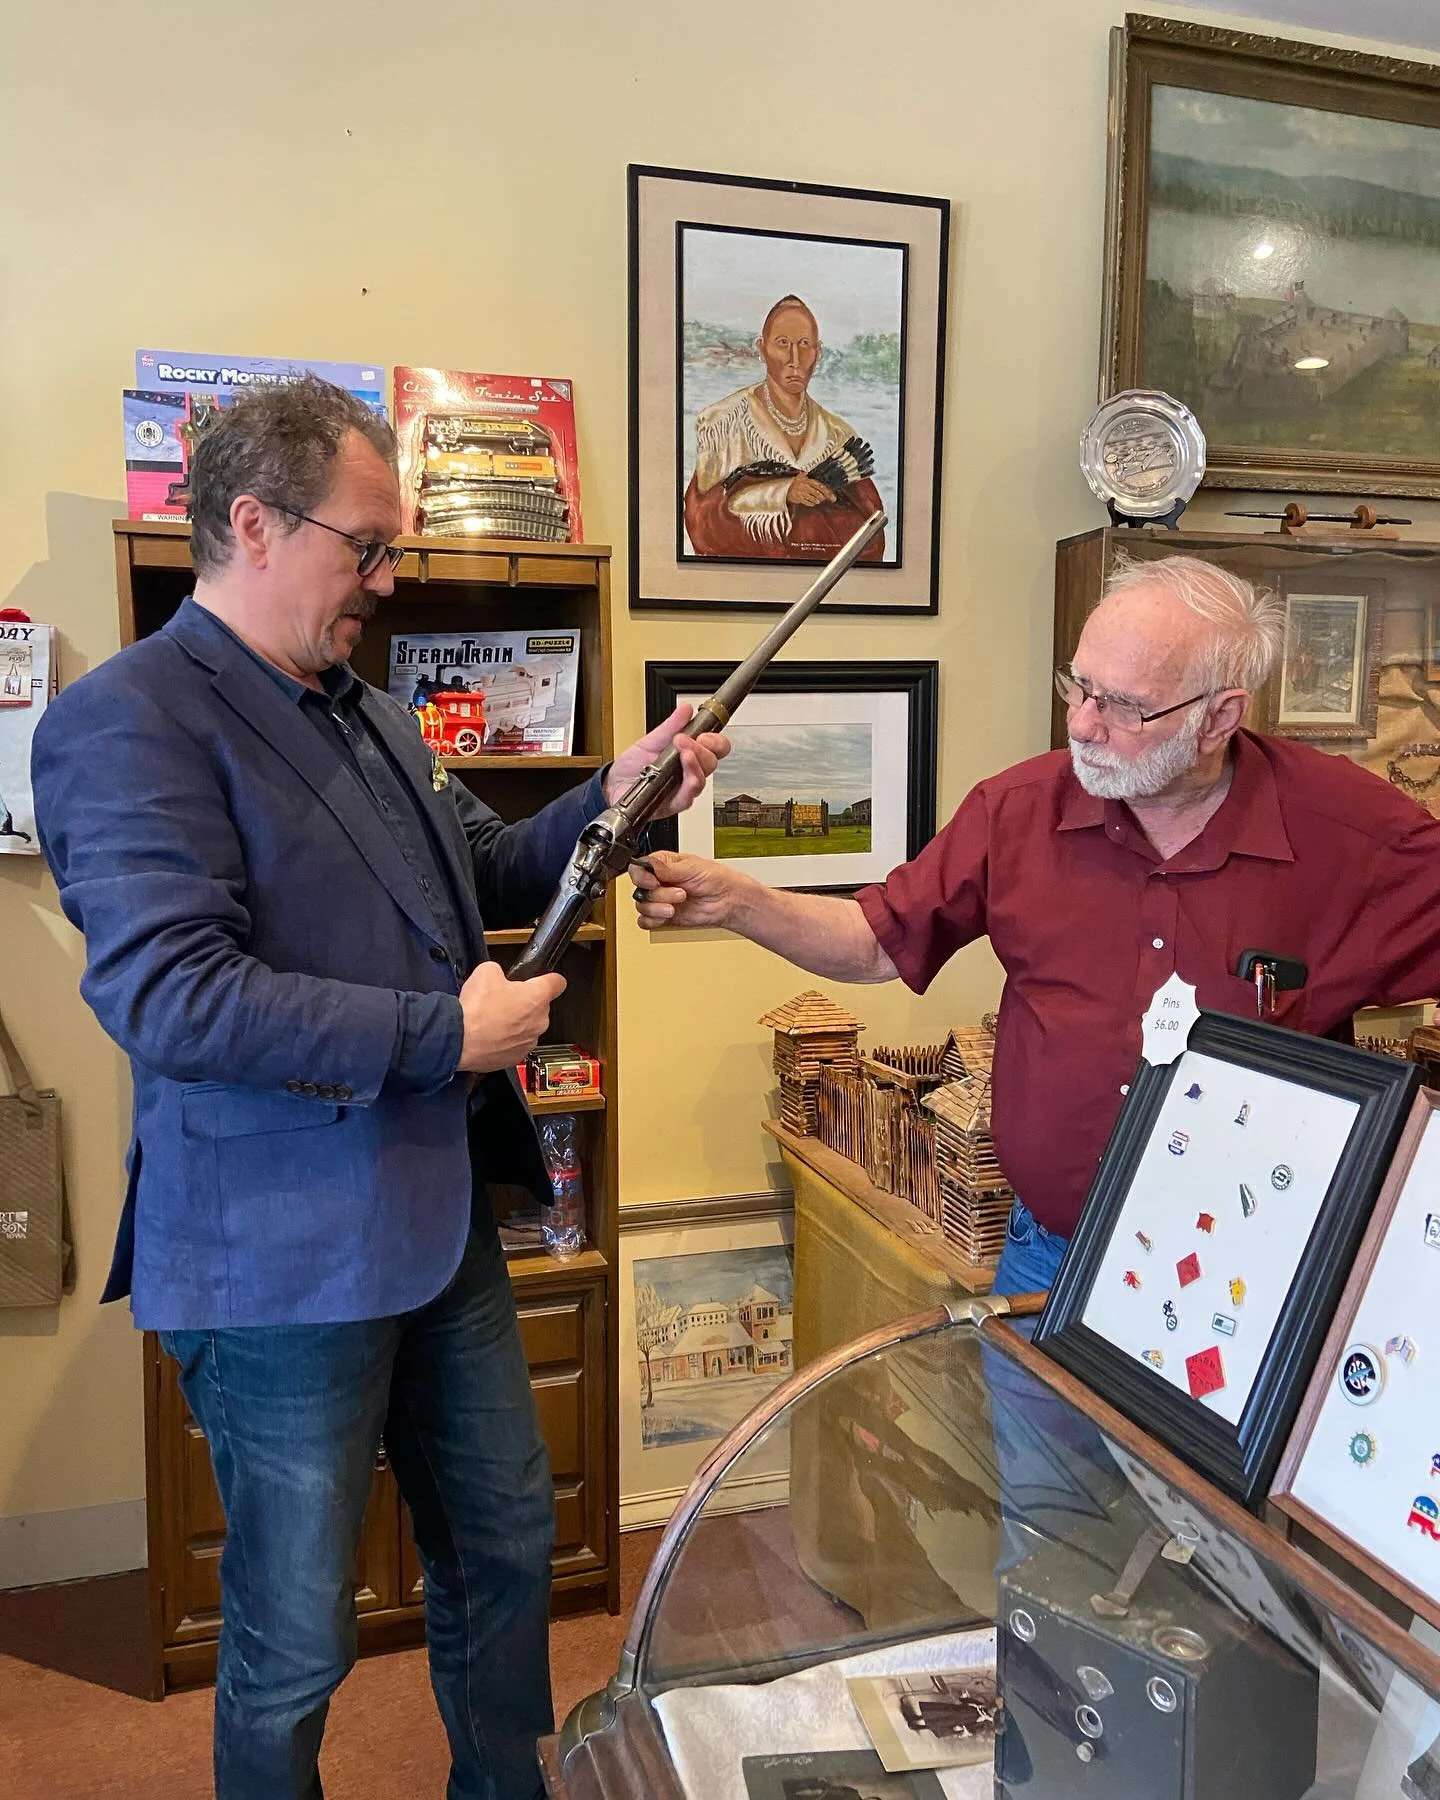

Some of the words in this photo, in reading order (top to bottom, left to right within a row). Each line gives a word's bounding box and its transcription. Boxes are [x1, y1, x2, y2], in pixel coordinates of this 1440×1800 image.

[158, 363, 217, 384] ROCKY
[475, 386, 524, 400] Train
[529, 390, 561, 402] Set
[158, 513, 189, 521] WARNIN
[397, 640, 455, 664] STEAM
[461, 639, 513, 664] TRAIN
[1162, 997, 1180, 1009] Pins
[1154, 1019, 1179, 1031] $6.00
